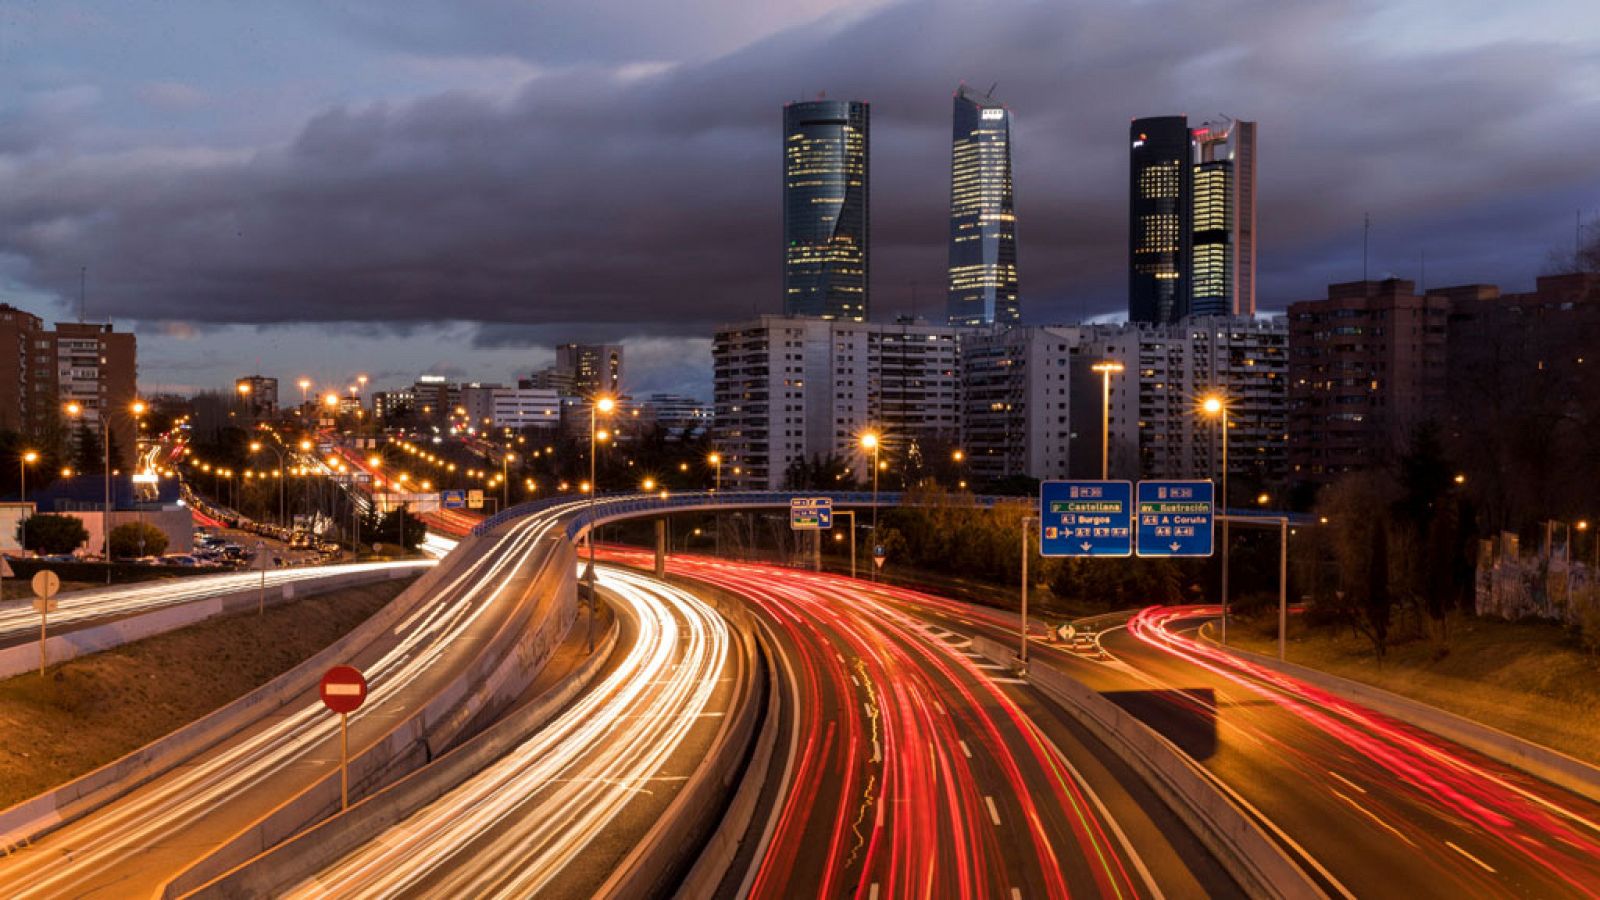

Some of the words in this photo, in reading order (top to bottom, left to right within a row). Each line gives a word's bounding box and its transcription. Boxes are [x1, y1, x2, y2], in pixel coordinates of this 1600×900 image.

[1069, 503, 1120, 512] Castellana
[1078, 515, 1110, 525] Burgos
[1174, 516, 1206, 524] Coruña
